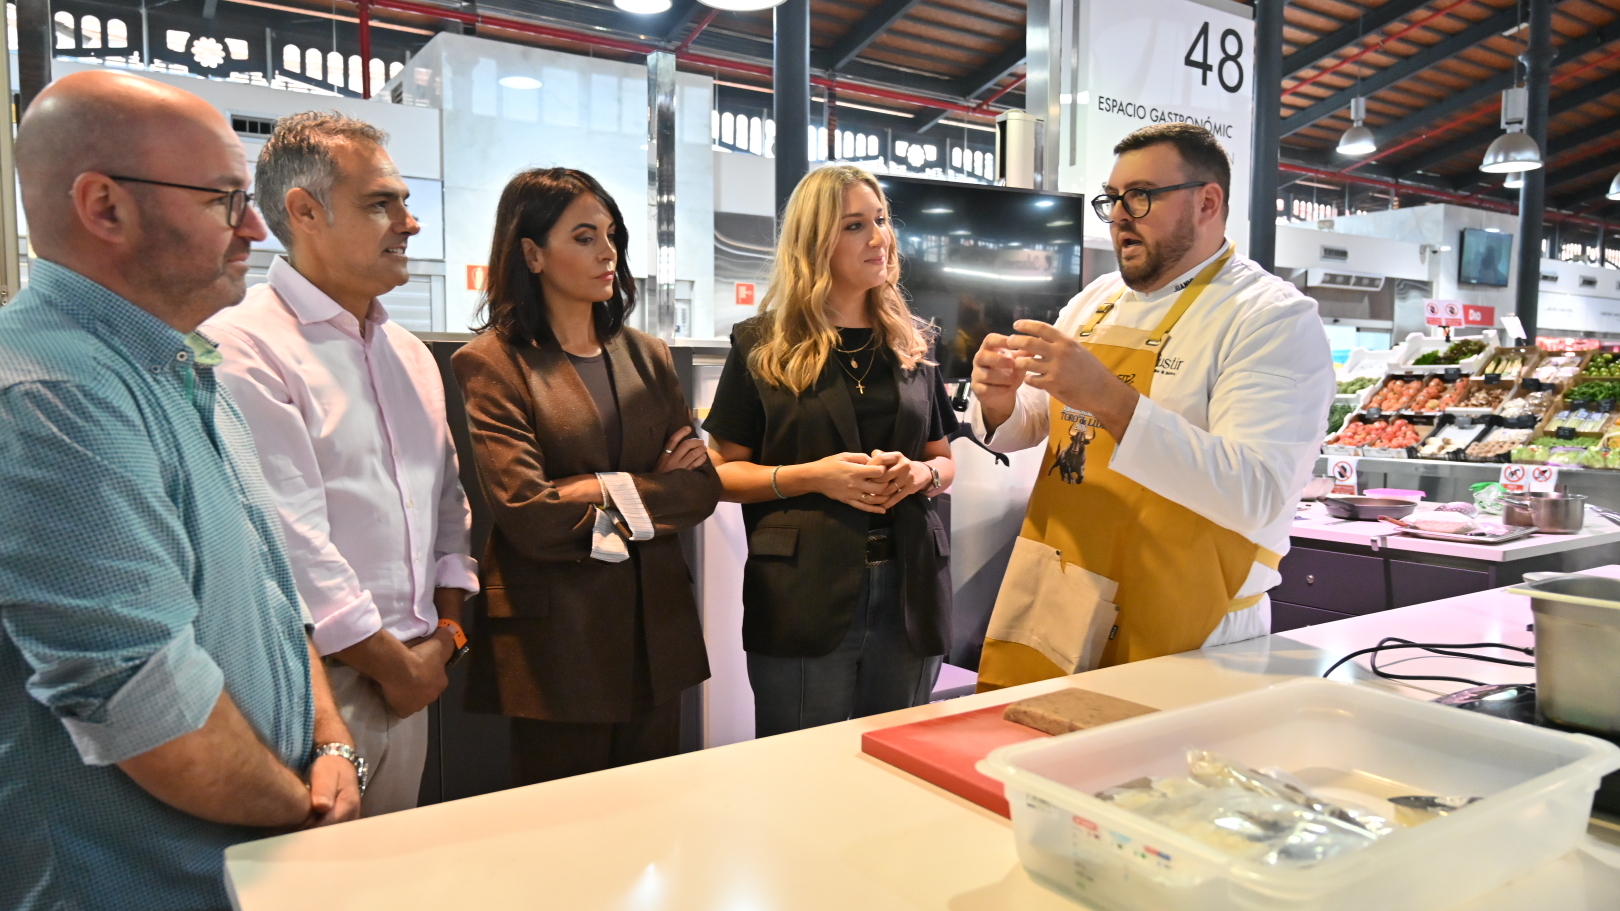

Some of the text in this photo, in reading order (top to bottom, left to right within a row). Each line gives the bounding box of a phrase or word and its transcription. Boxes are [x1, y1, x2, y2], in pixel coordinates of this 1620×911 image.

[1184, 21, 1244, 94] 48
[1098, 96, 1147, 120] ESPACIO
[1157, 356, 1184, 370] ustir
